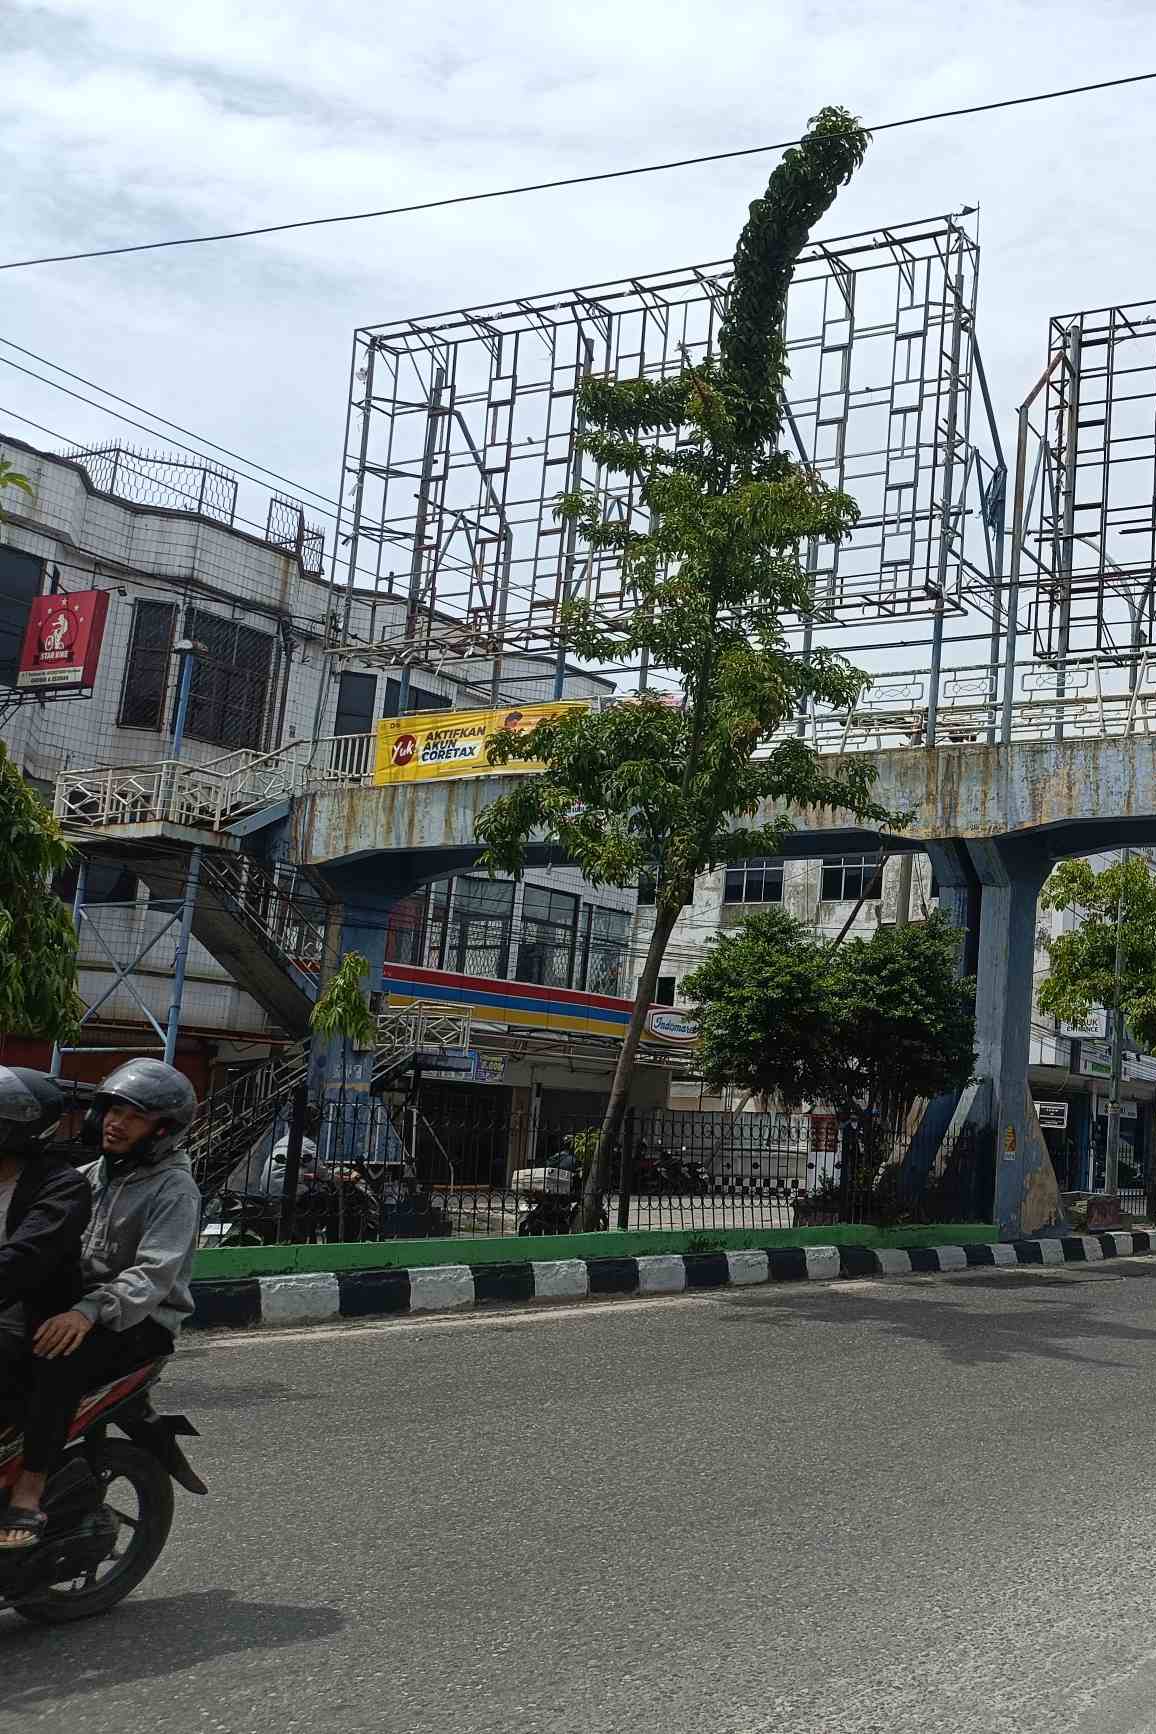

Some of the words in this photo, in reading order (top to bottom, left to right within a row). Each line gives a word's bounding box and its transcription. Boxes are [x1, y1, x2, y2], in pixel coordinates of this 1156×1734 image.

[426, 726, 485, 741] AKTIFKAN
[391, 740, 415, 765] Yuk
[422, 739, 457, 752] AKUN
[421, 746, 477, 762] CORETAX
